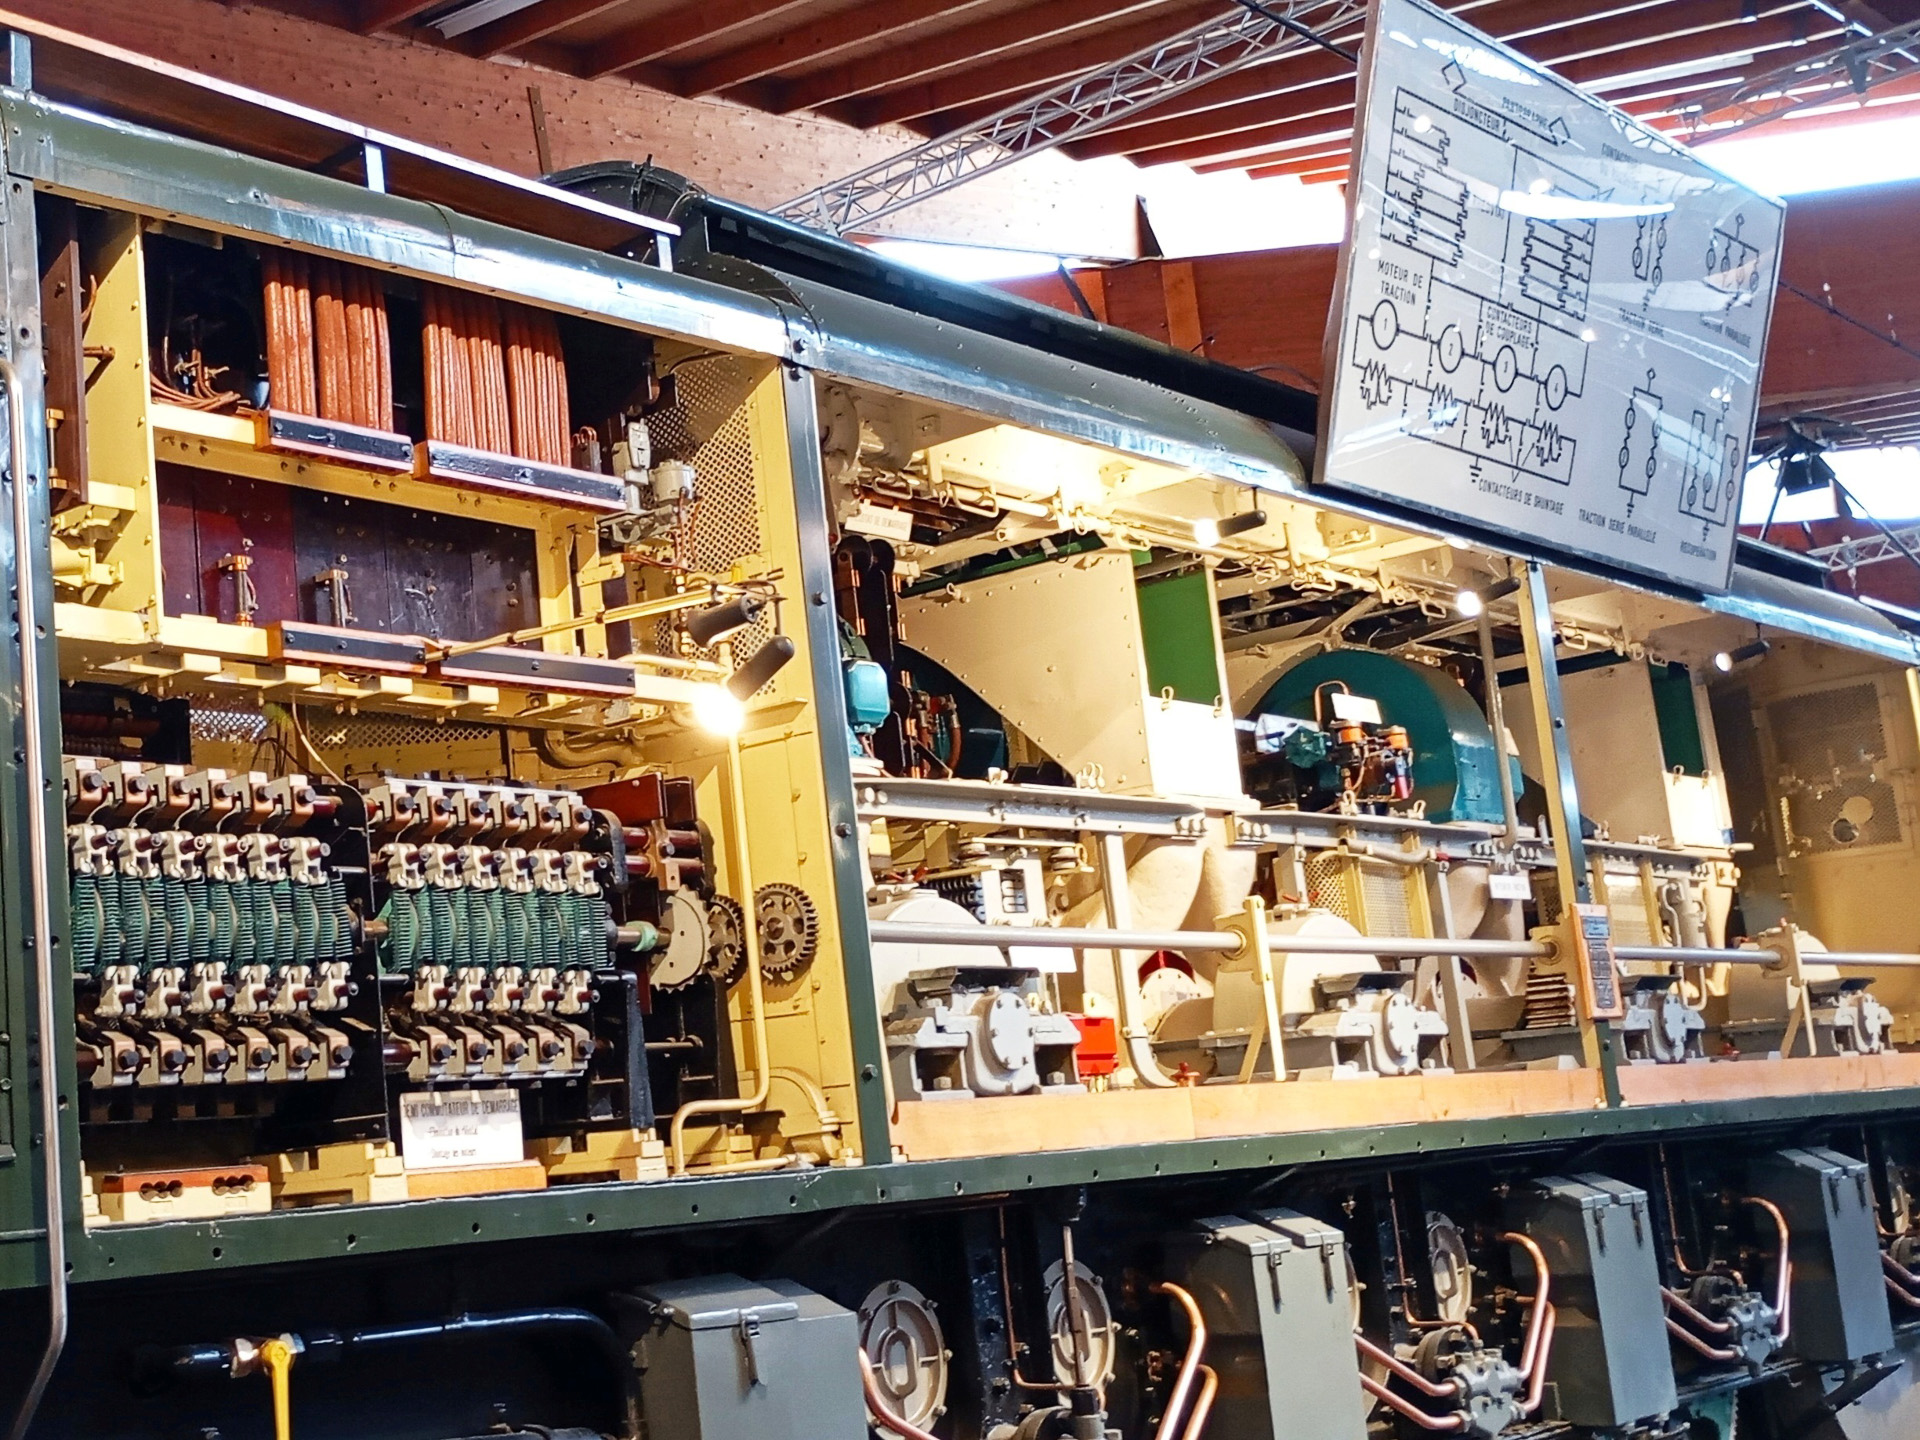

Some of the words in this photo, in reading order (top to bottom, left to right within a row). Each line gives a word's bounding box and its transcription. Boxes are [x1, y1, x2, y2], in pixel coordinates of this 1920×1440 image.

[1453, 98, 1500, 132] DISJONCTEUR
[1377, 260, 1408, 282] MOTEUR
[1412, 276, 1424, 290] DE
[1380, 280, 1416, 306] TRACTION
[1485, 320, 1495, 337] DE
[1496, 324, 1532, 350] COUPLAGE
[1486, 305, 1533, 335] CONTACTEURS
[1479, 478, 1523, 504] CONTACTEURS
[1523, 491, 1533, 506] DE
[1579, 508, 1606, 527] TRACTION
